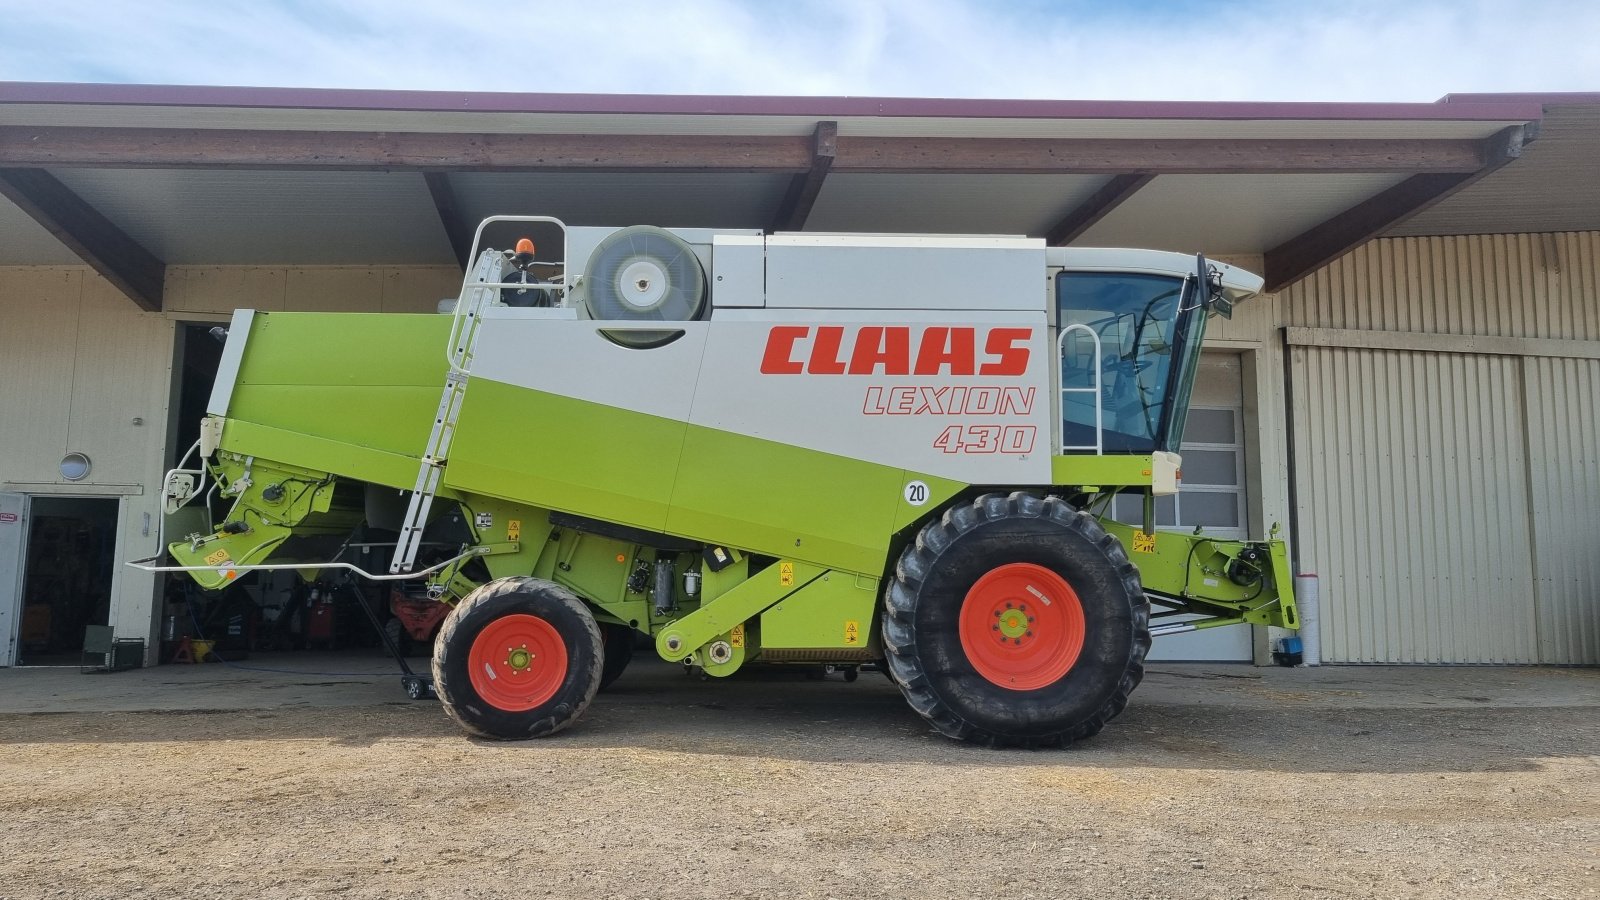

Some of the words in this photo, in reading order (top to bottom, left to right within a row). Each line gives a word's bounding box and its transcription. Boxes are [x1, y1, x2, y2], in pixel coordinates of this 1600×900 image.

[760, 326, 1032, 376] CLAAS
[863, 387, 1036, 415] LEXION
[933, 426, 1037, 454] 430
[909, 484, 925, 502] 20
